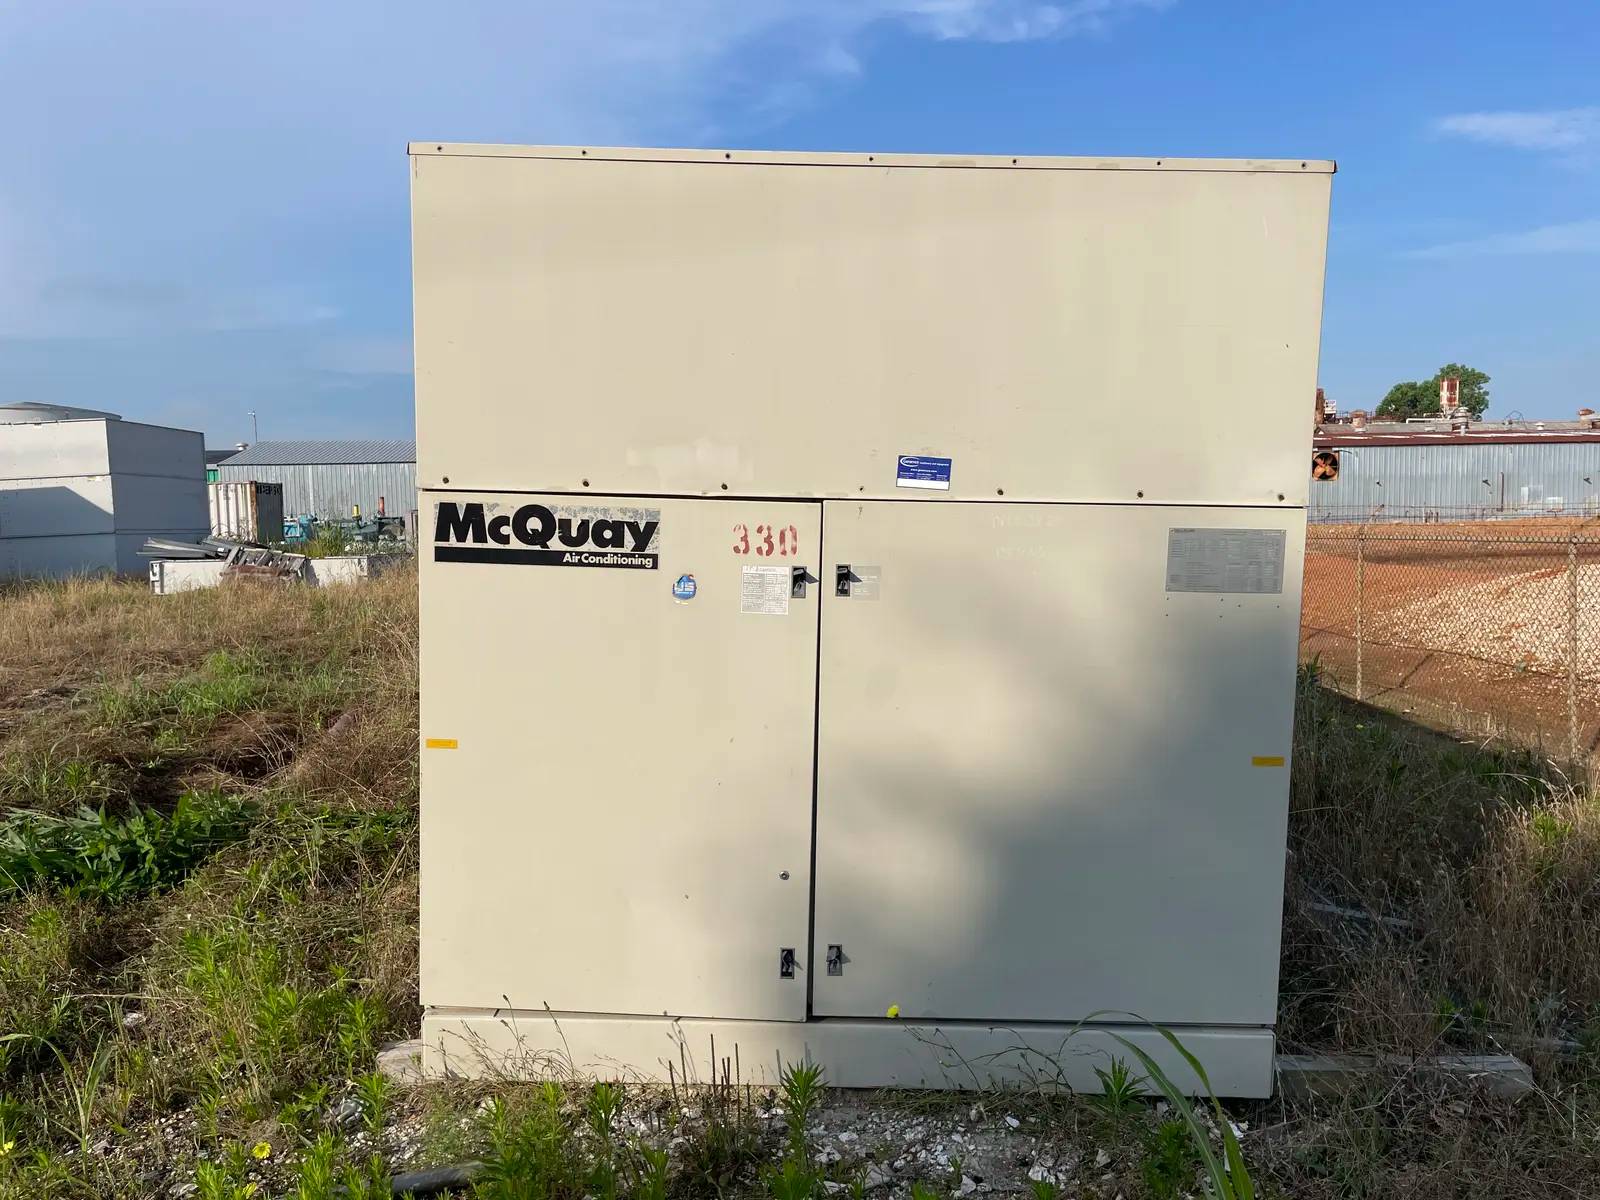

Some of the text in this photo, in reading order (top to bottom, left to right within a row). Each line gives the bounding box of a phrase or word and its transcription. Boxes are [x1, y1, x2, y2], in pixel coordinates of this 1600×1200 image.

[434, 501, 659, 552] McQuay
[732, 523, 799, 557] 330
[562, 552, 653, 568] Air Conditioning
